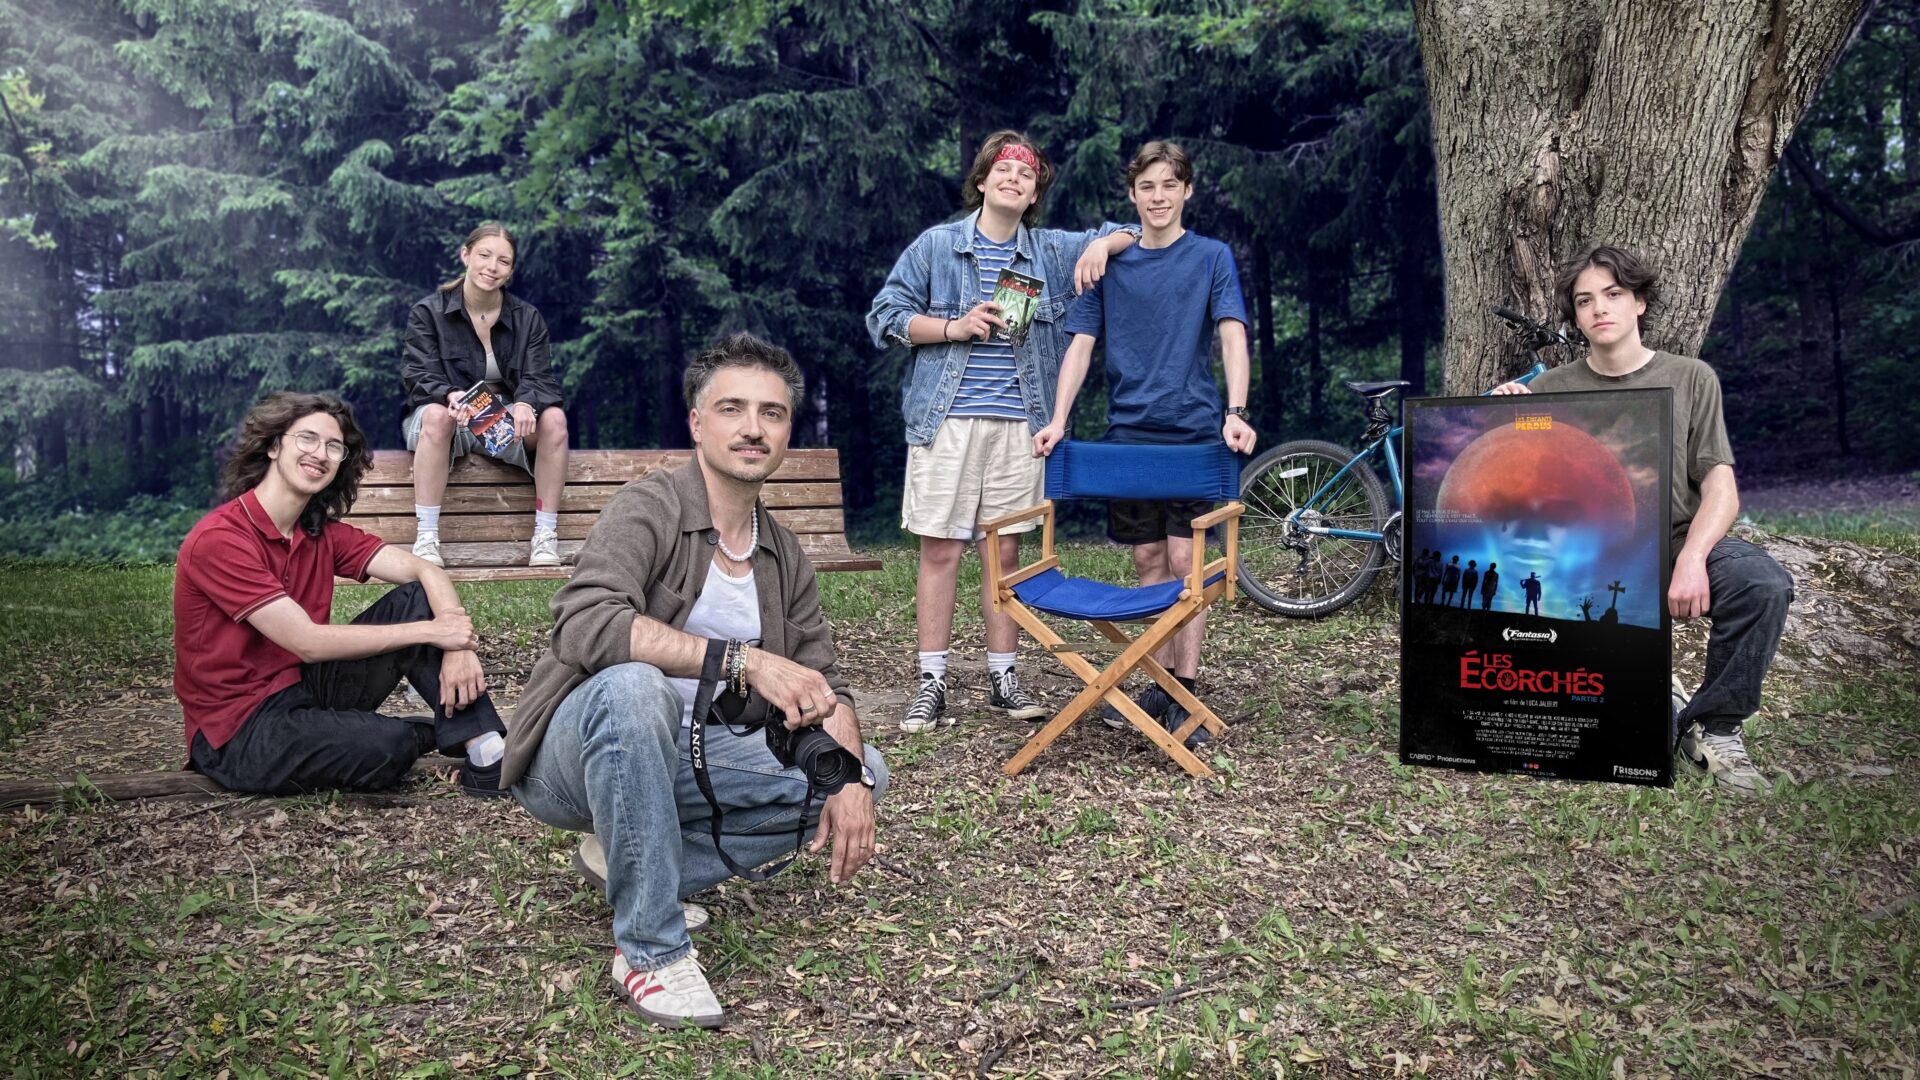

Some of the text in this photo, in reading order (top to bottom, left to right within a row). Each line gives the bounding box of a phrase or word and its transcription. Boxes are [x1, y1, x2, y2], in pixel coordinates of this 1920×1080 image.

[1515, 421, 1552, 430] PERDUS
[1509, 629, 1550, 638] Fantasia
[1483, 653, 1512, 668] LES
[1460, 650, 1605, 696] ÉCORCHÉS
[1571, 695, 1598, 703] PARTIE
[692, 719, 702, 769] SONY
[1613, 765, 1658, 777] FRISSONS
